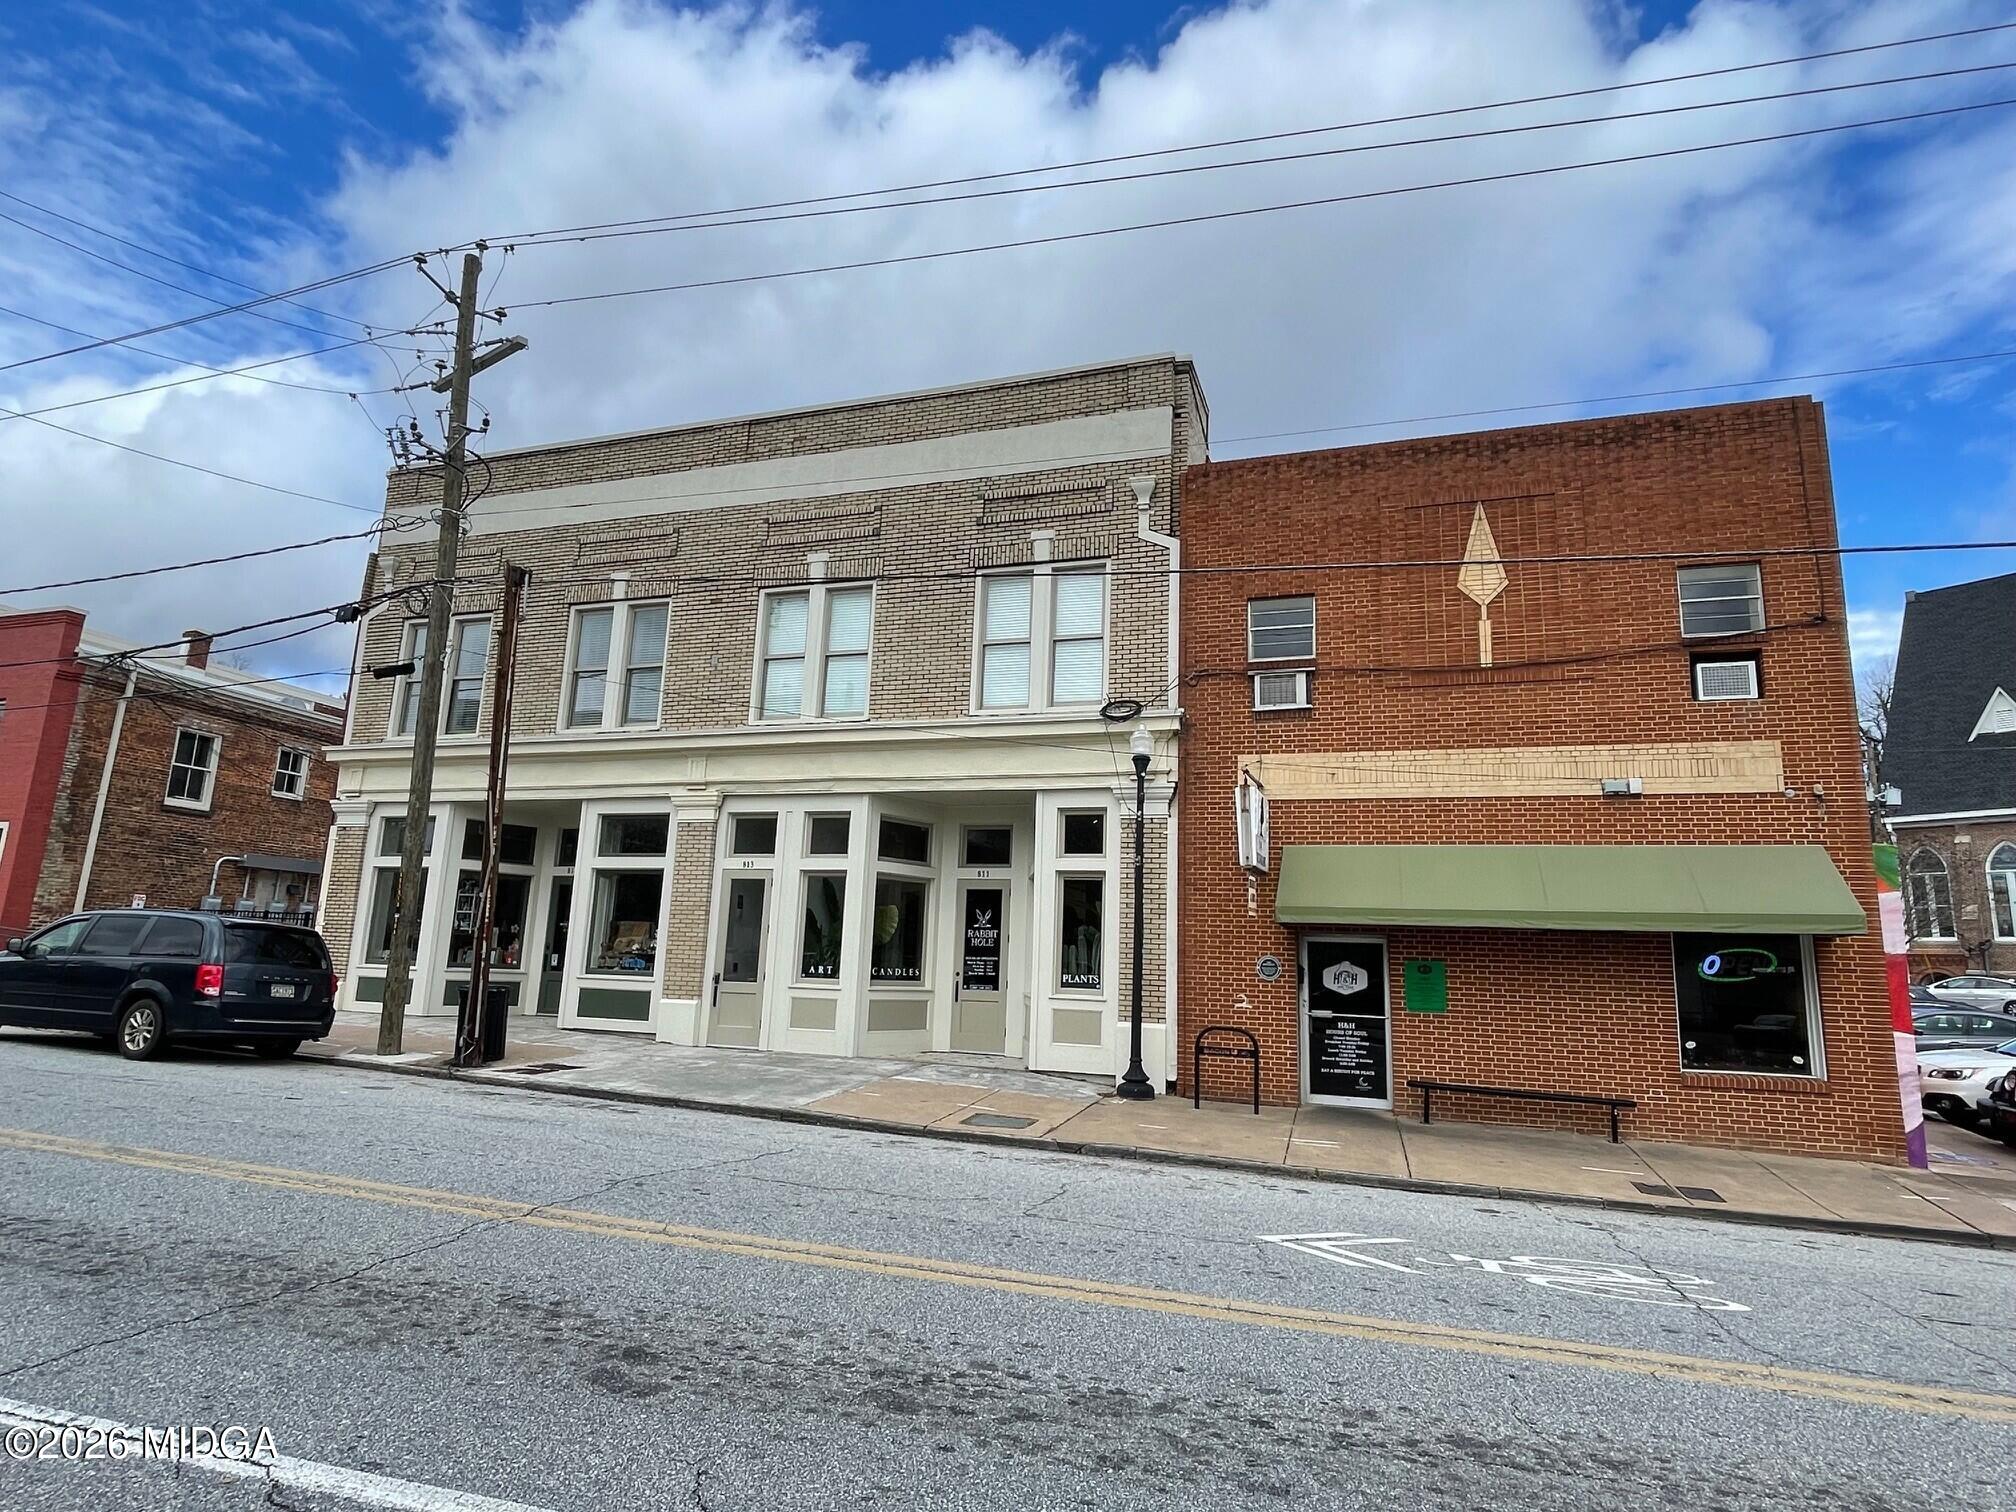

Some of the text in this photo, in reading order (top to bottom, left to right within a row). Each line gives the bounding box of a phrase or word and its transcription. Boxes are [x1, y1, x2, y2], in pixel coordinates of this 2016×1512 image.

[742, 860, 754, 868] 813
[977, 870, 990, 878] 811
[967, 929, 999, 938] RABBIT
[971, 938, 995, 947] HOLE
[808, 965, 834, 975] ART
[872, 967, 920, 976] CANDLES
[1062, 974, 1100, 984] PLANTS
